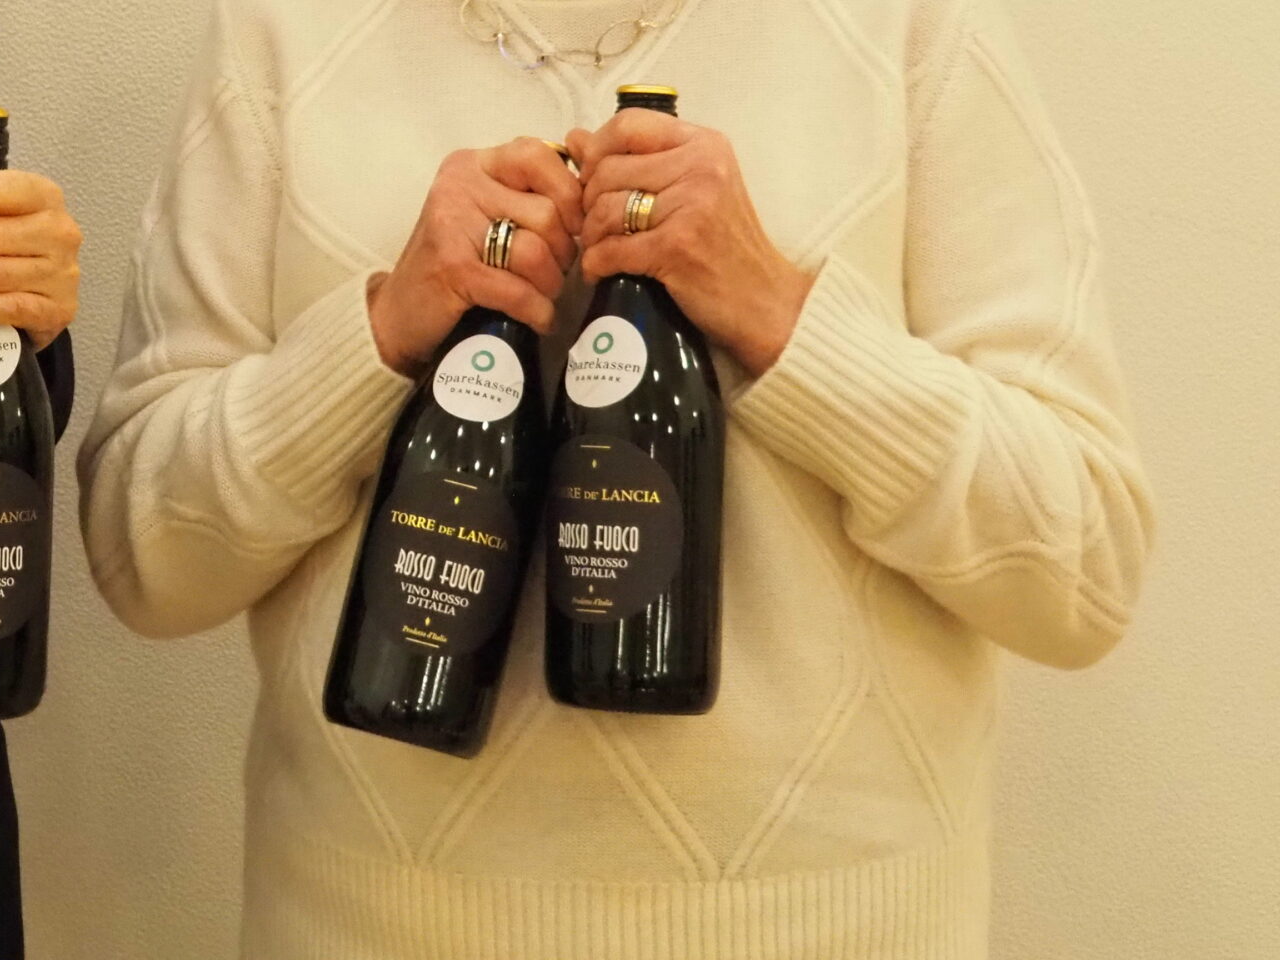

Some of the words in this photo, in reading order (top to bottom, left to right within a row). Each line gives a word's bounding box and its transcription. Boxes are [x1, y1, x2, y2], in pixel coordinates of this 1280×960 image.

[437, 372, 520, 399] Sparekassen
[576, 375, 621, 383] DANMARK
[450, 387, 502, 403] DANMARK
[602, 488, 660, 503] LANCIA
[391, 510, 436, 531] TORRE
[457, 527, 508, 551] LANCIA
[558, 522, 588, 550] ROSSO
[594, 525, 639, 552] FUOCO
[394, 548, 436, 582] ROSSO
[440, 560, 485, 594] FUOCO
[564, 555, 589, 566] VINO
[590, 557, 628, 568] ROSSO
[571, 567, 617, 579] D'ITALIA
[400, 581, 430, 598] VINO
[431, 590, 469, 608] ROSSO
[407, 595, 456, 616] D'ITALIA
